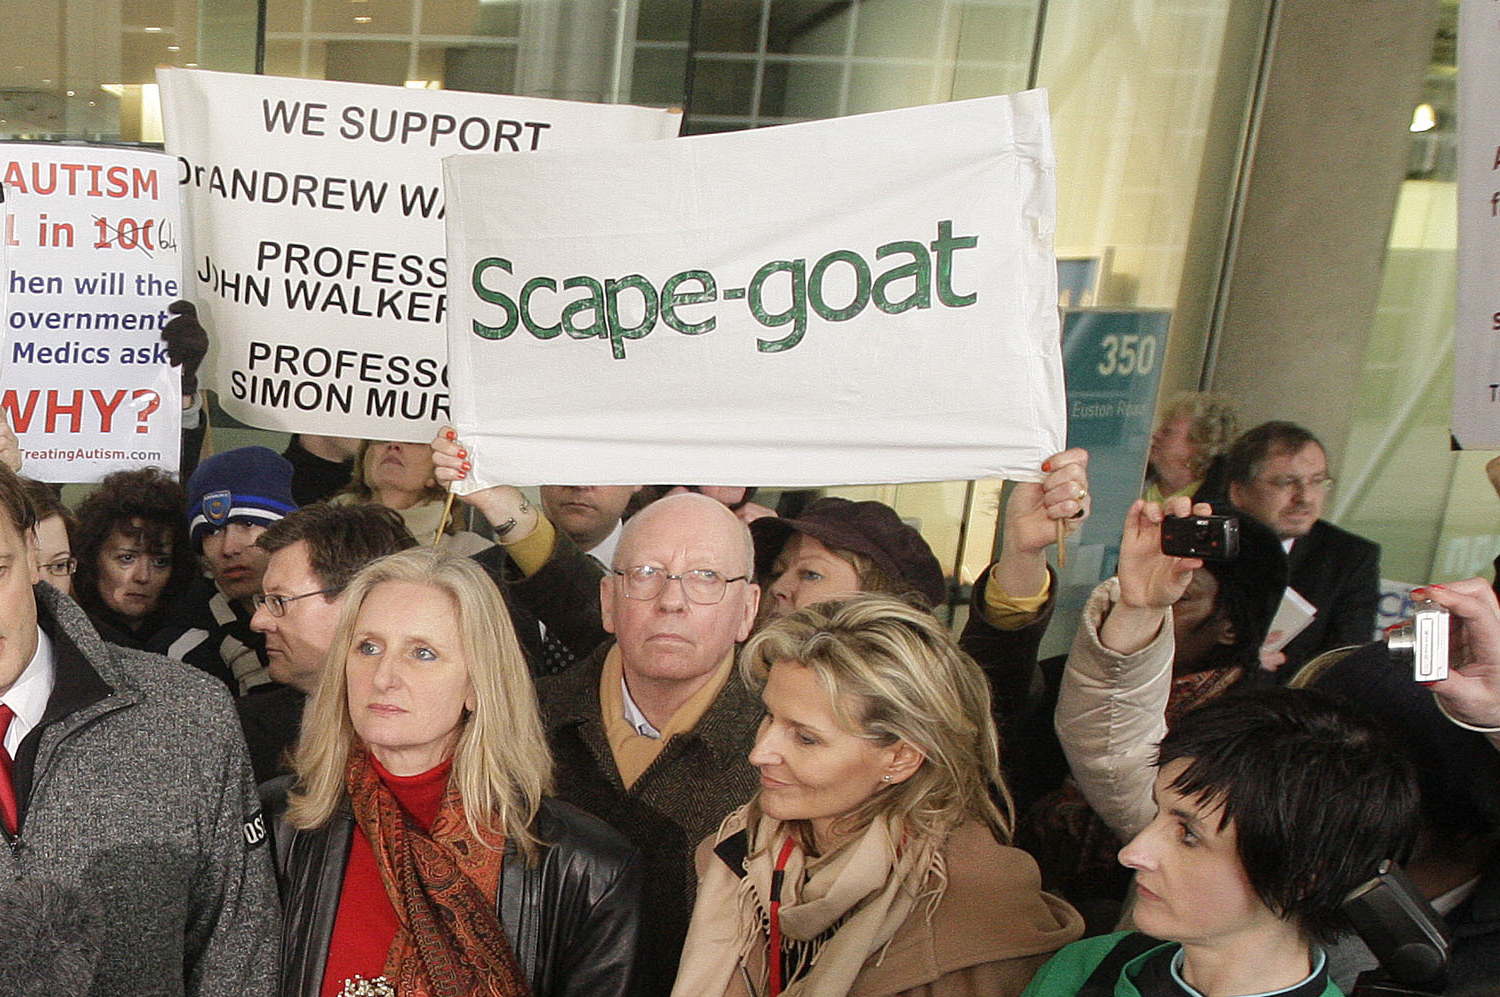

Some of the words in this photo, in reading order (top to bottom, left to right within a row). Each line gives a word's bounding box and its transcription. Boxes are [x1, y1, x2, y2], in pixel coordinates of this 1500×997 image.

[263, 98, 328, 136] WE
[339, 105, 552, 153] SUPPORT
[3, 161, 159, 200] AUTISM
[209, 165, 388, 214] ANDREW
[401, 183, 447, 220] W
[38, 213, 74, 247] in
[74, 272, 125, 295] will
[135, 273, 179, 297] the
[198, 256, 271, 307] JHN
[470, 219, 980, 360] Scape-goat
[12, 342, 110, 364] Medics
[120, 343, 169, 365] ask
[1098, 334, 1157, 376] 350
[1, 389, 161, 434] WHY?
[231, 370, 354, 414] SIMON
